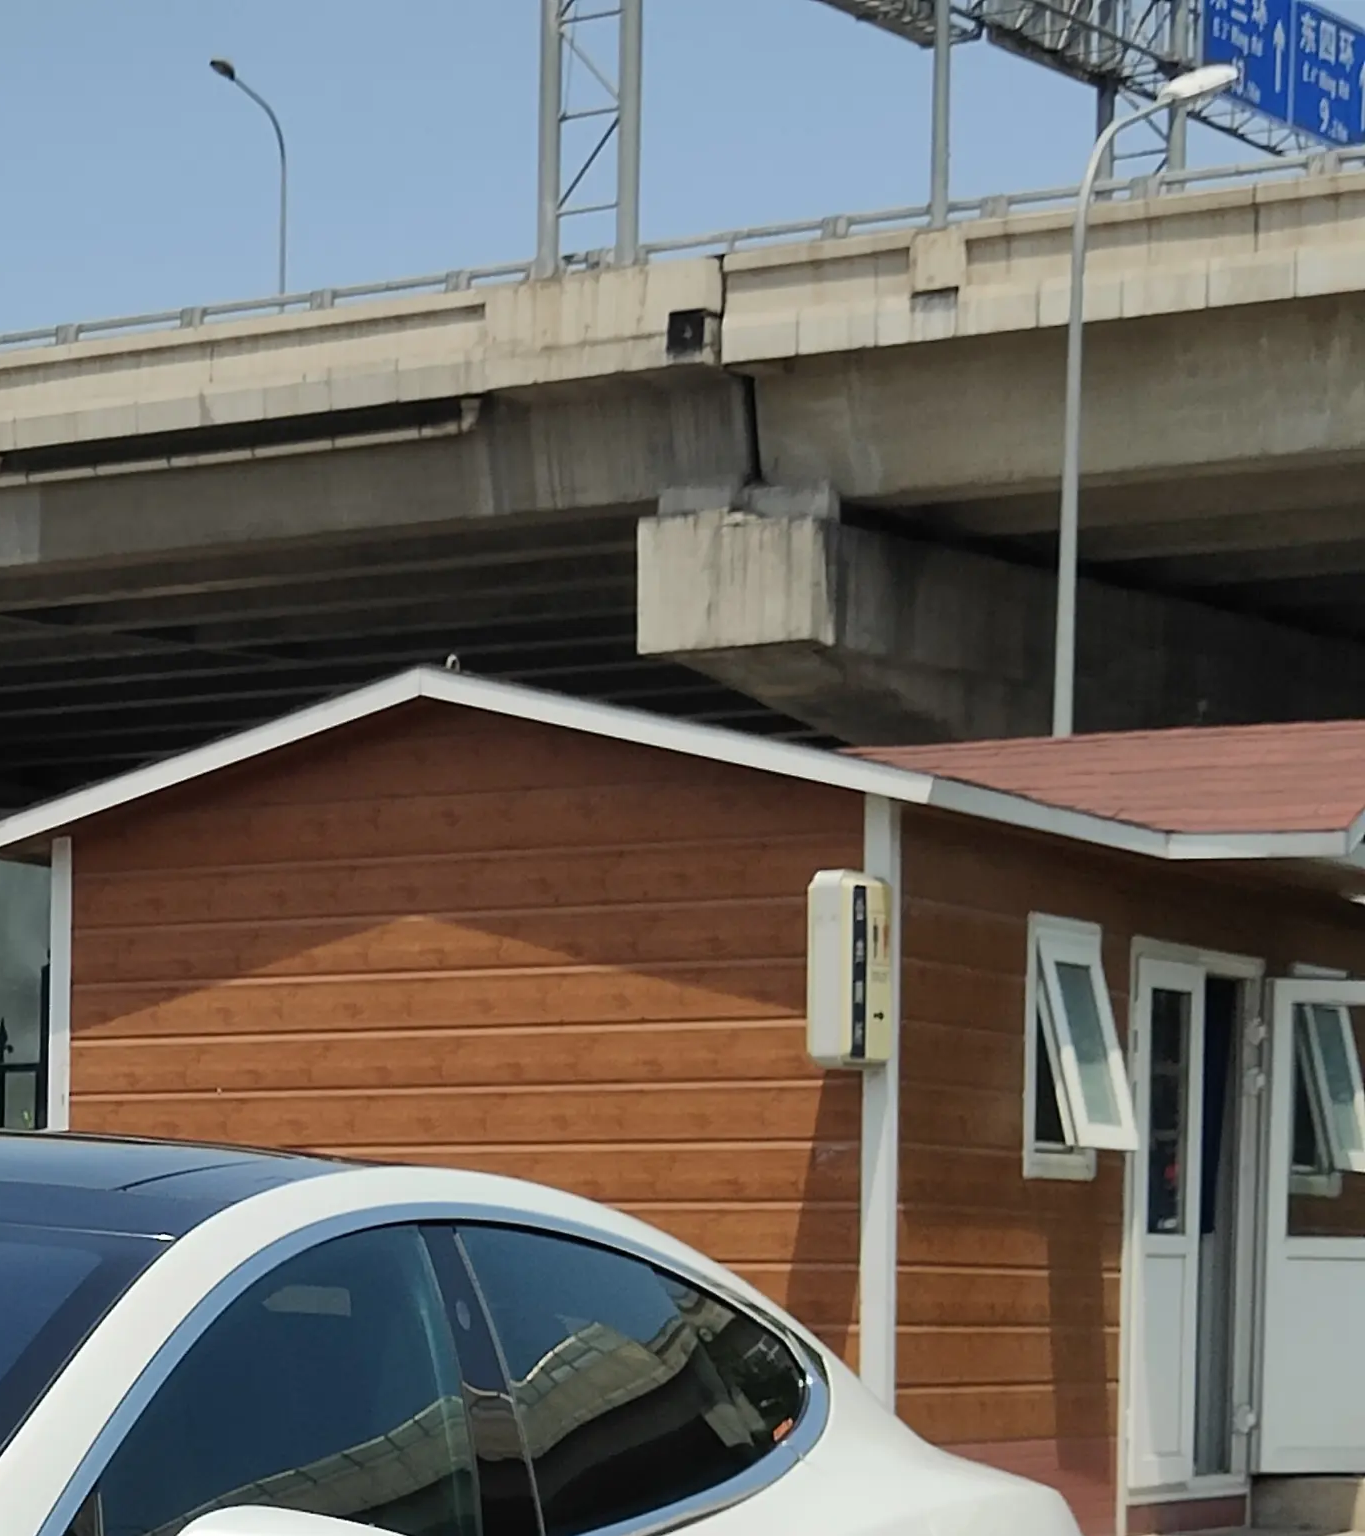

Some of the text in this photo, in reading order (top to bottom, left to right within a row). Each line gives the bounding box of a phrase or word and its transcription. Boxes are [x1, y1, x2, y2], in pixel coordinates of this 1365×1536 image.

[1209, 0, 1268, 32] 三环
[1300, 12, 1356, 73] 东四环
